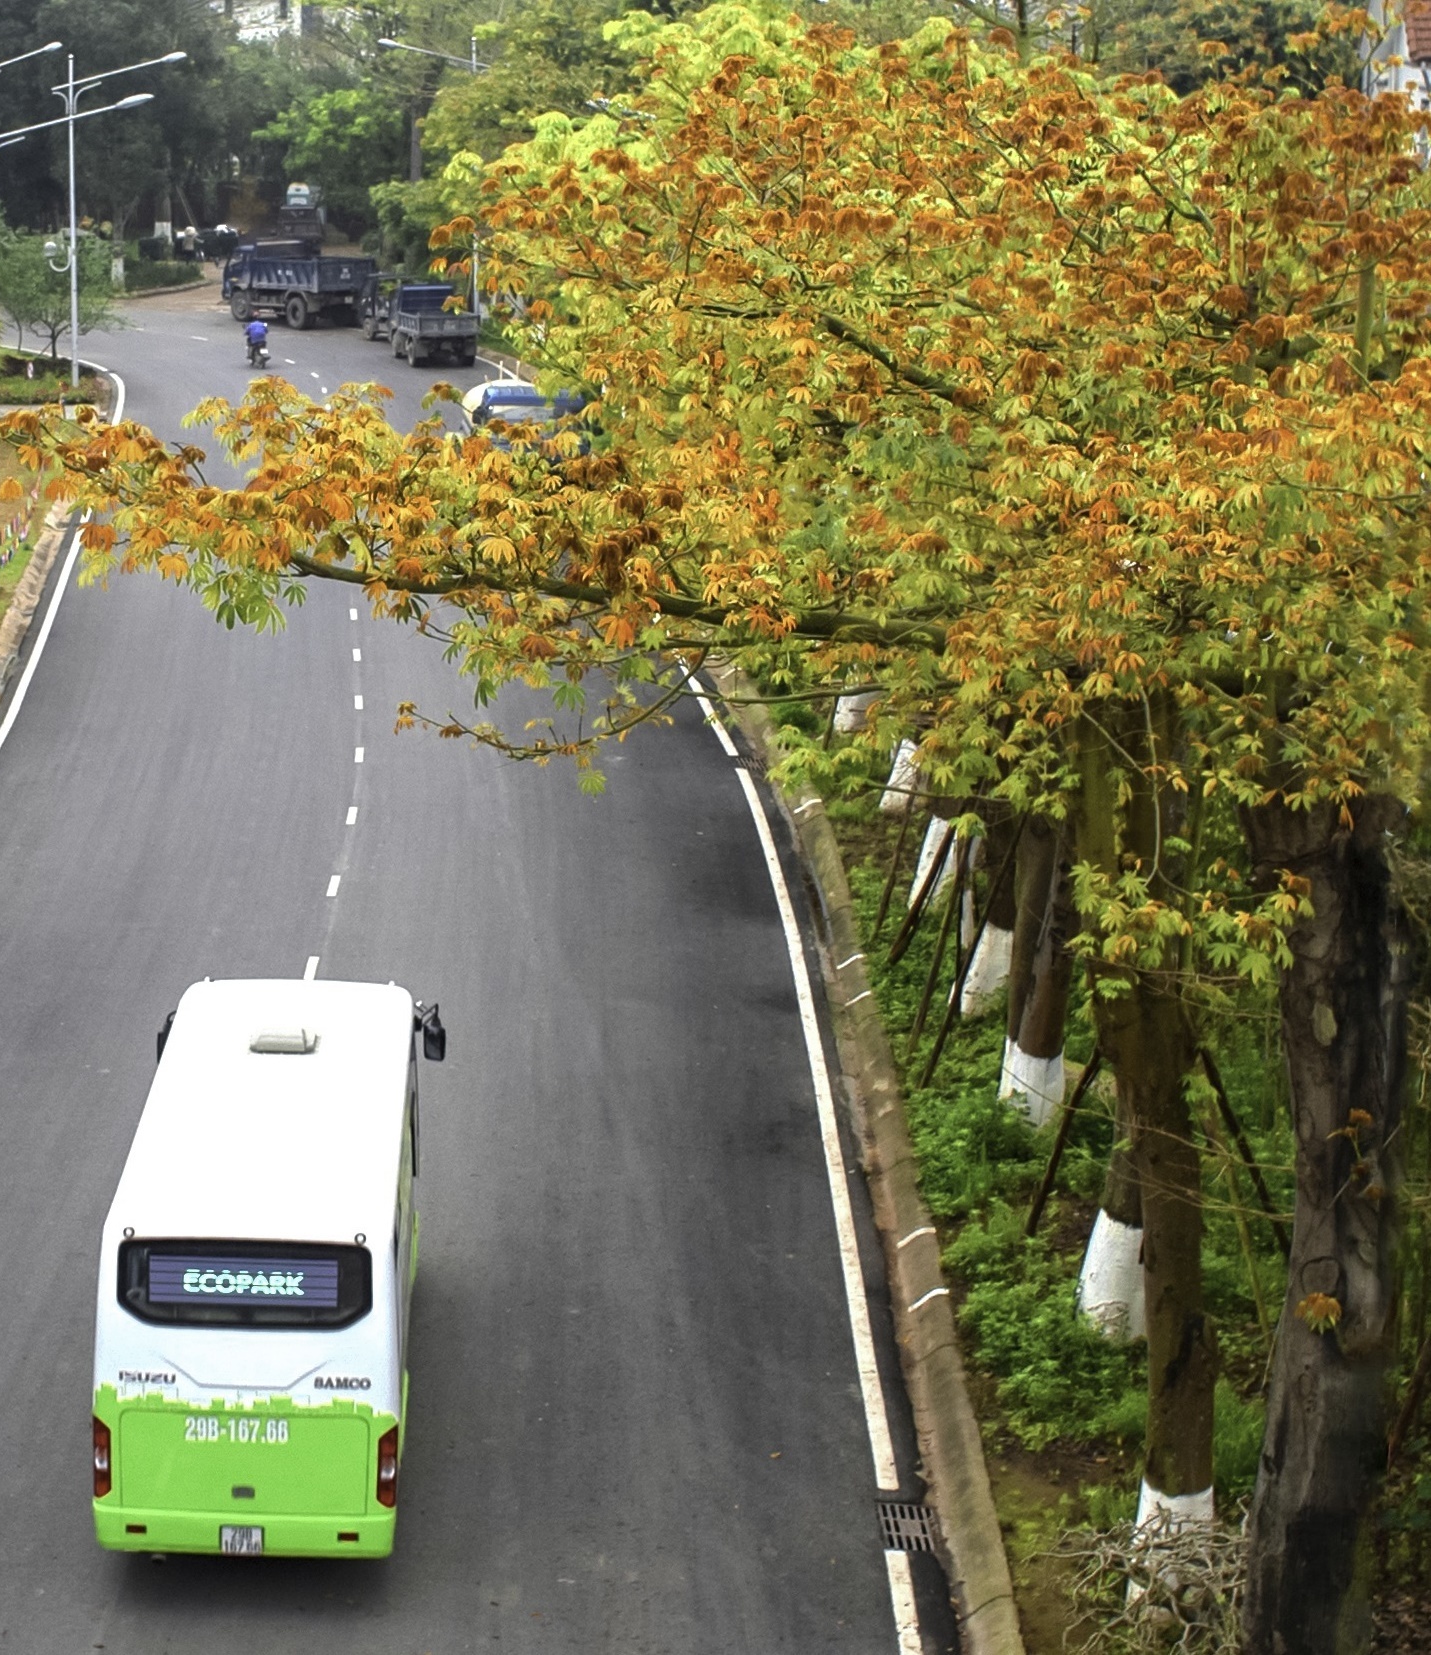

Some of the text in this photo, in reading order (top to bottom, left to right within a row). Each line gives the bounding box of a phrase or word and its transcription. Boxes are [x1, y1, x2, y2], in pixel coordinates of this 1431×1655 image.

[183, 1268, 305, 1296] ECOPARK
[118, 1370, 176, 1385] ISUZU
[314, 1376, 372, 1391] SAMCO
[184, 1416, 289, 1444] 29B-167.66
